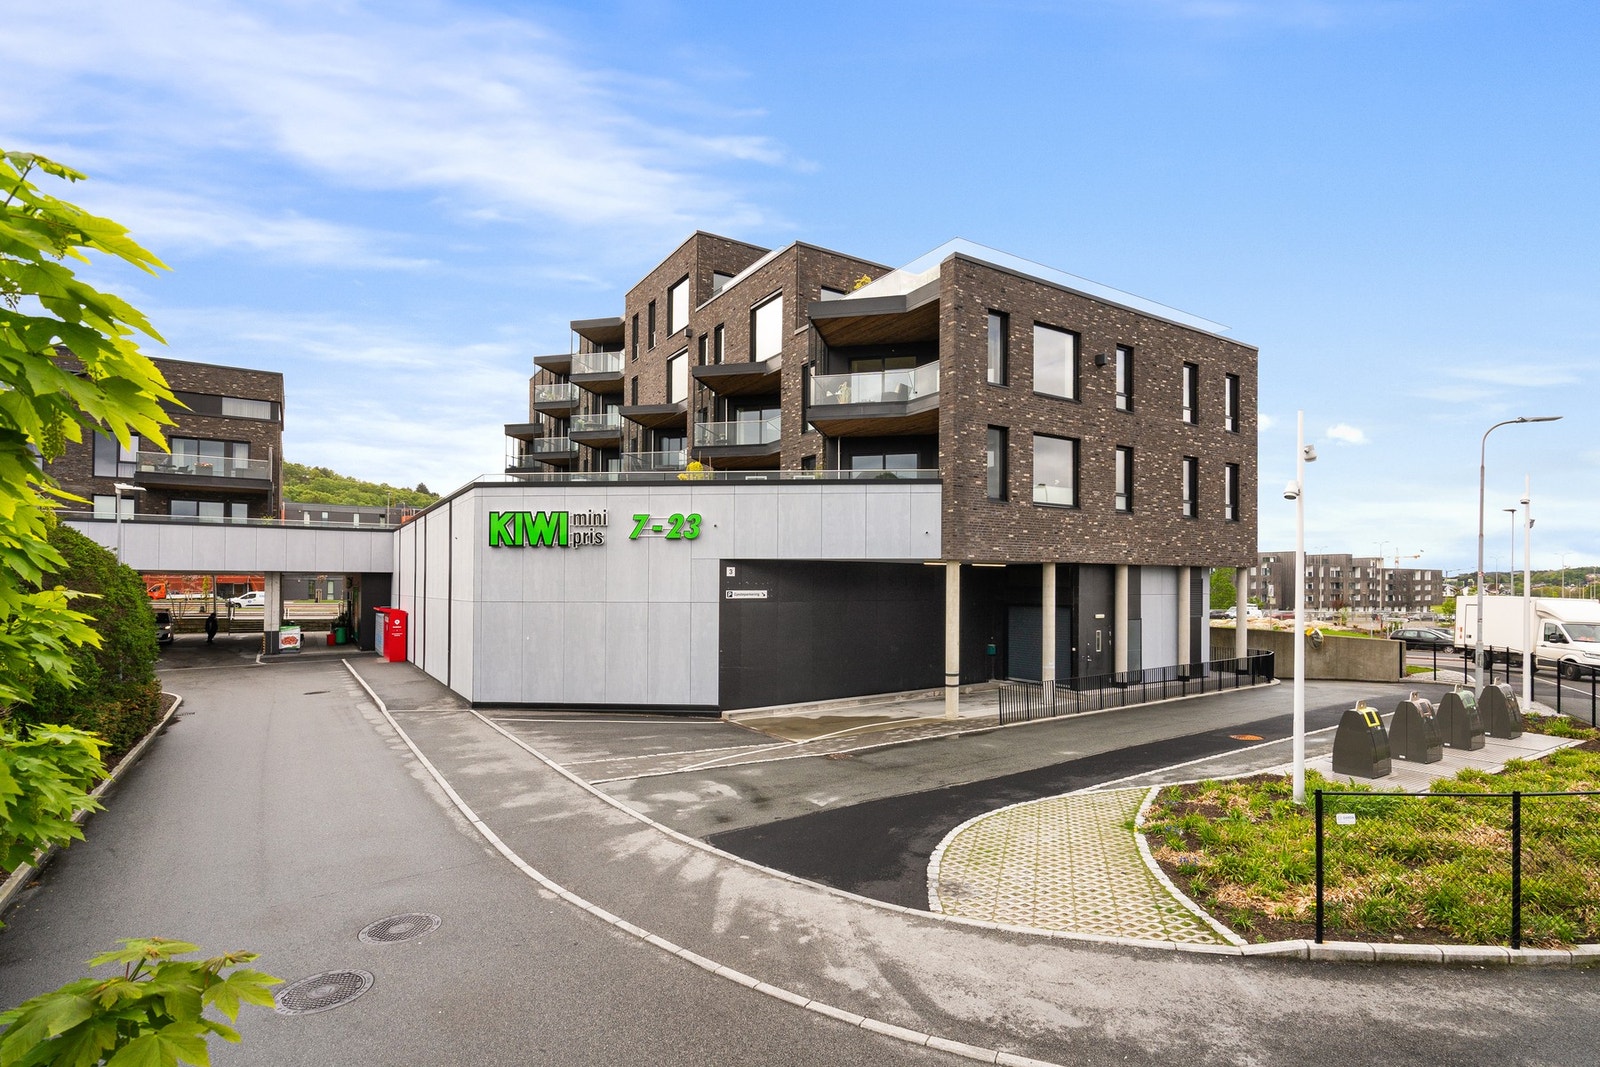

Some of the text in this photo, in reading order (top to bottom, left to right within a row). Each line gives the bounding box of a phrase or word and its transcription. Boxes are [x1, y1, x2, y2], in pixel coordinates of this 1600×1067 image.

[573, 509, 607, 525] mini
[489, 511, 569, 546] KIWI
[573, 528, 604, 547] pris
